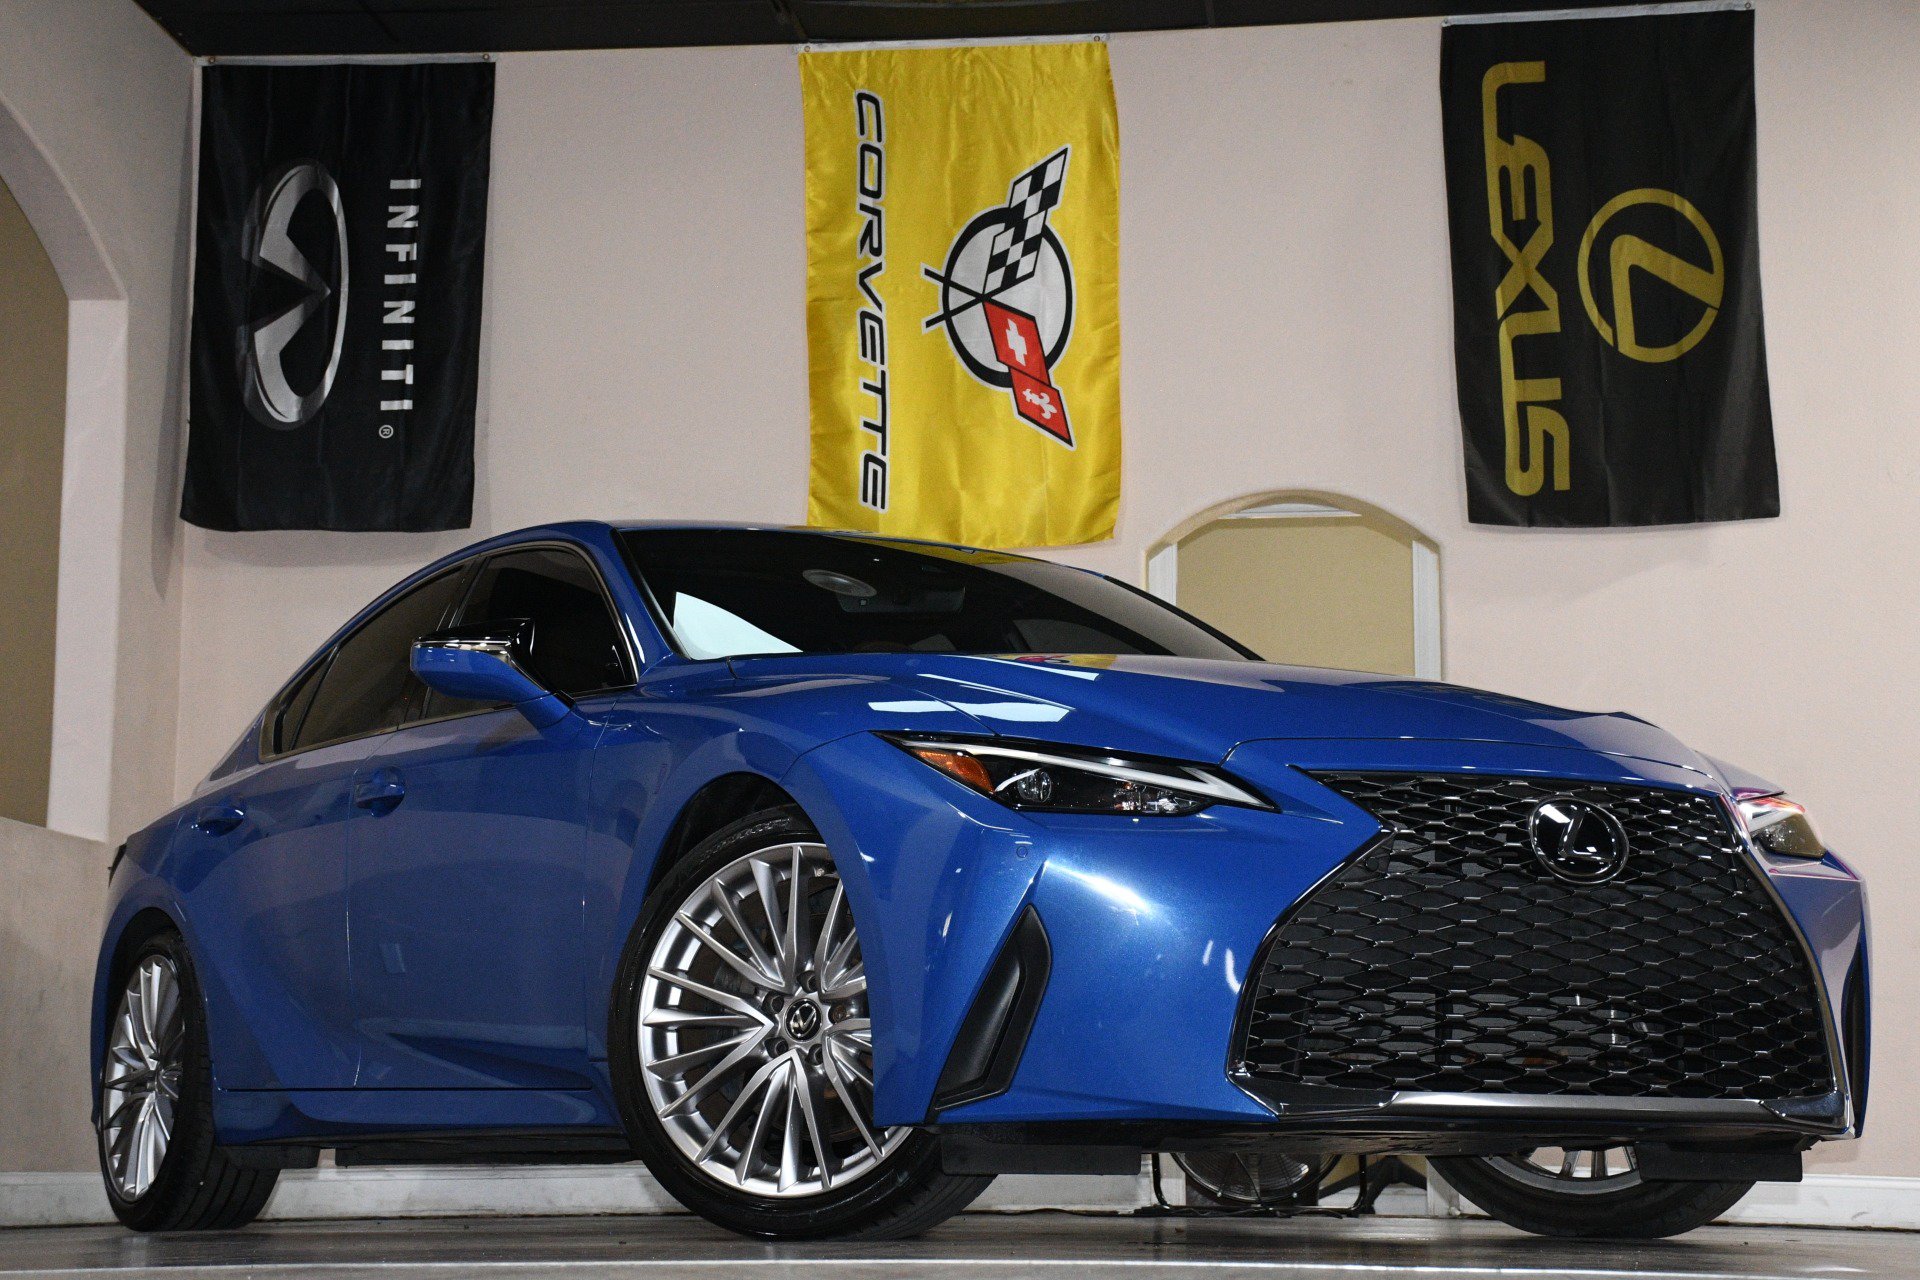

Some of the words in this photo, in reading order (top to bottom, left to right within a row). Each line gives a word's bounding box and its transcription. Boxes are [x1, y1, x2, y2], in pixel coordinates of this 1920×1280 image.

[380, 178, 422, 411] INFINITI
[855, 90, 890, 512] CORVETTE
[1481, 60, 1571, 497] LEXUS
